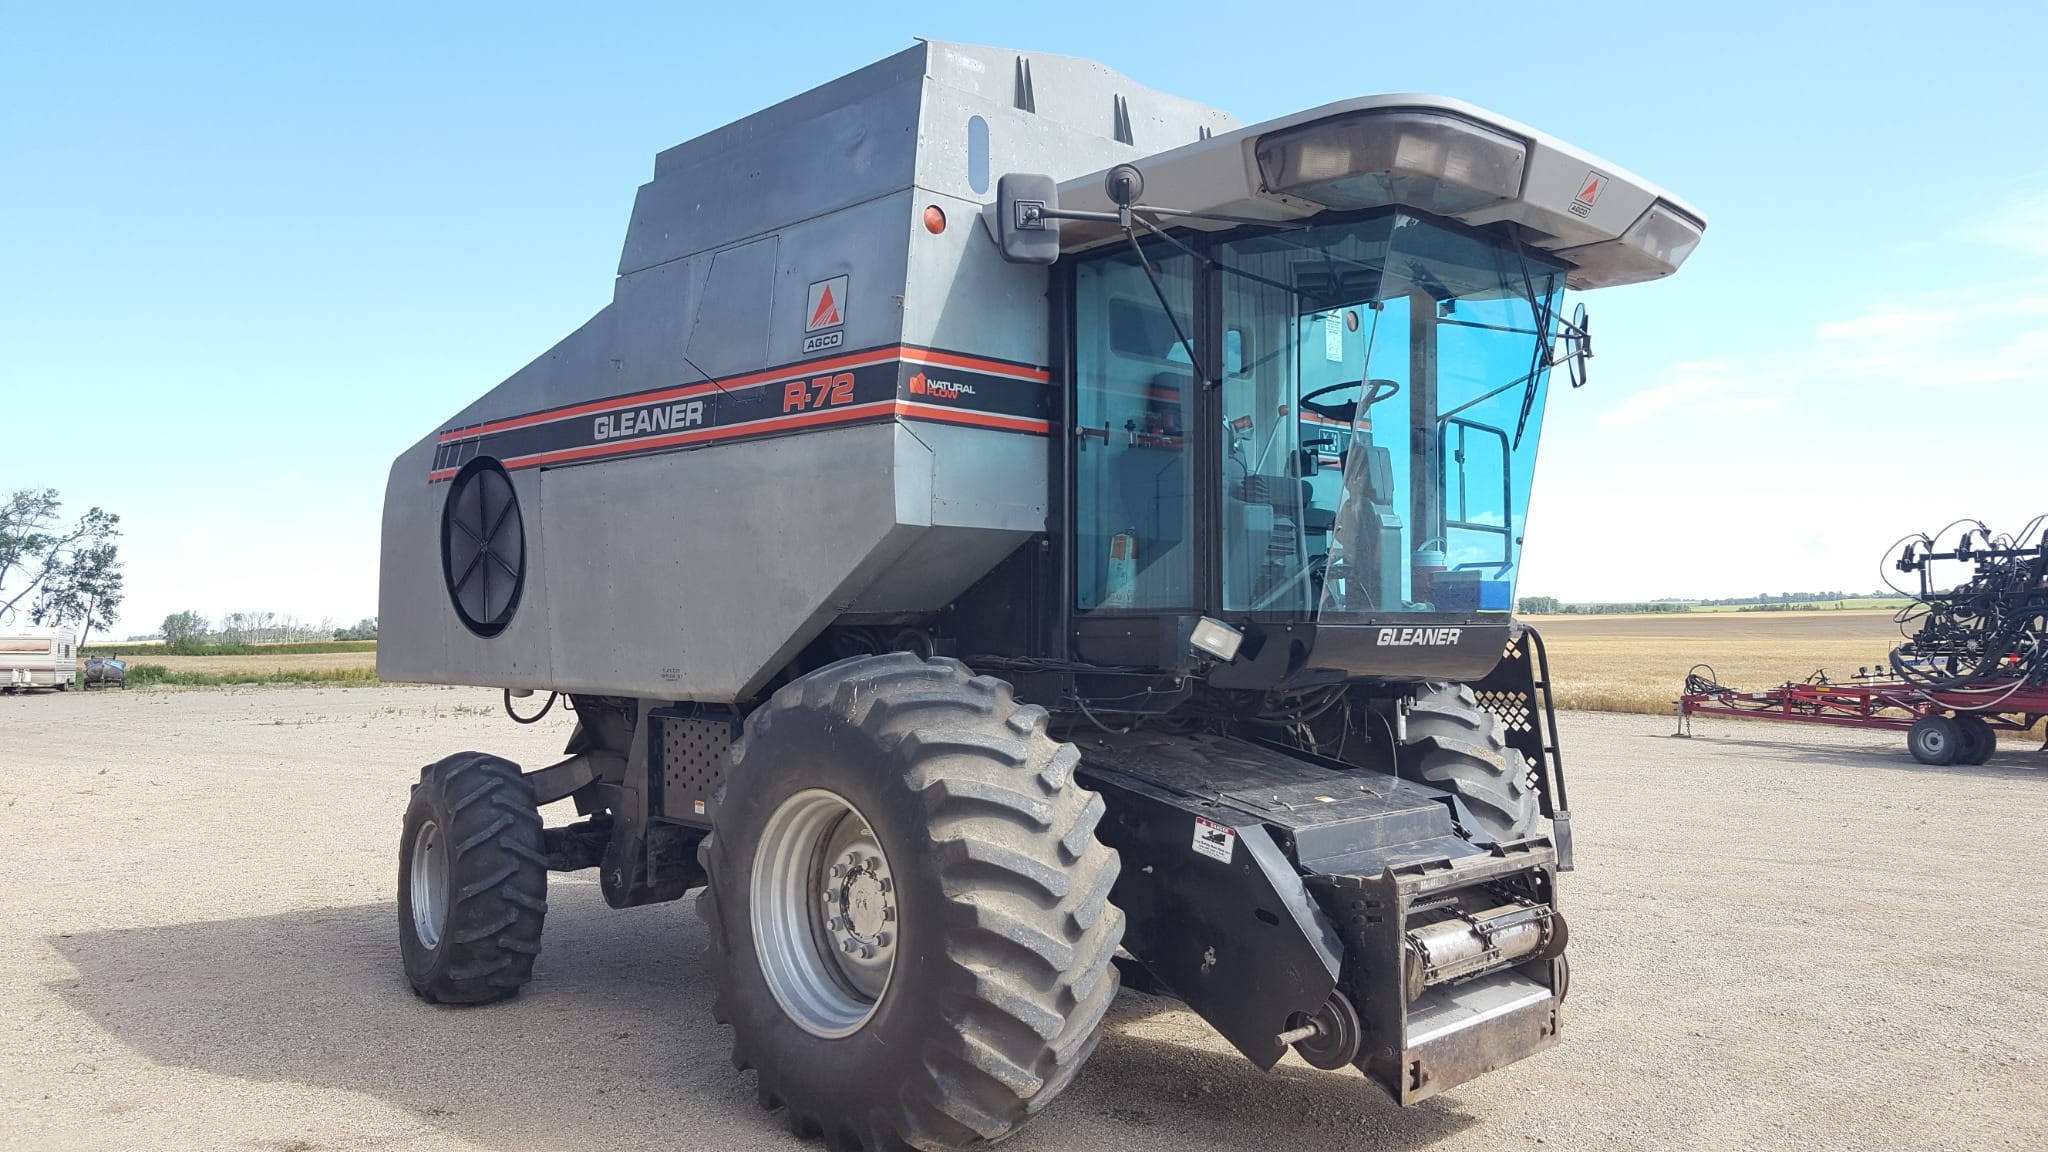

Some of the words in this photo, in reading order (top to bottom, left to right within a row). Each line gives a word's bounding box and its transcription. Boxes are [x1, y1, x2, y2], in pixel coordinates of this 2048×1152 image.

[807, 334, 839, 350] AGCO
[927, 379, 976, 395] NATURAL
[927, 387, 959, 400] FLOW
[594, 401, 703, 440] GLEANER
[1376, 628, 1460, 646] GLEANER
